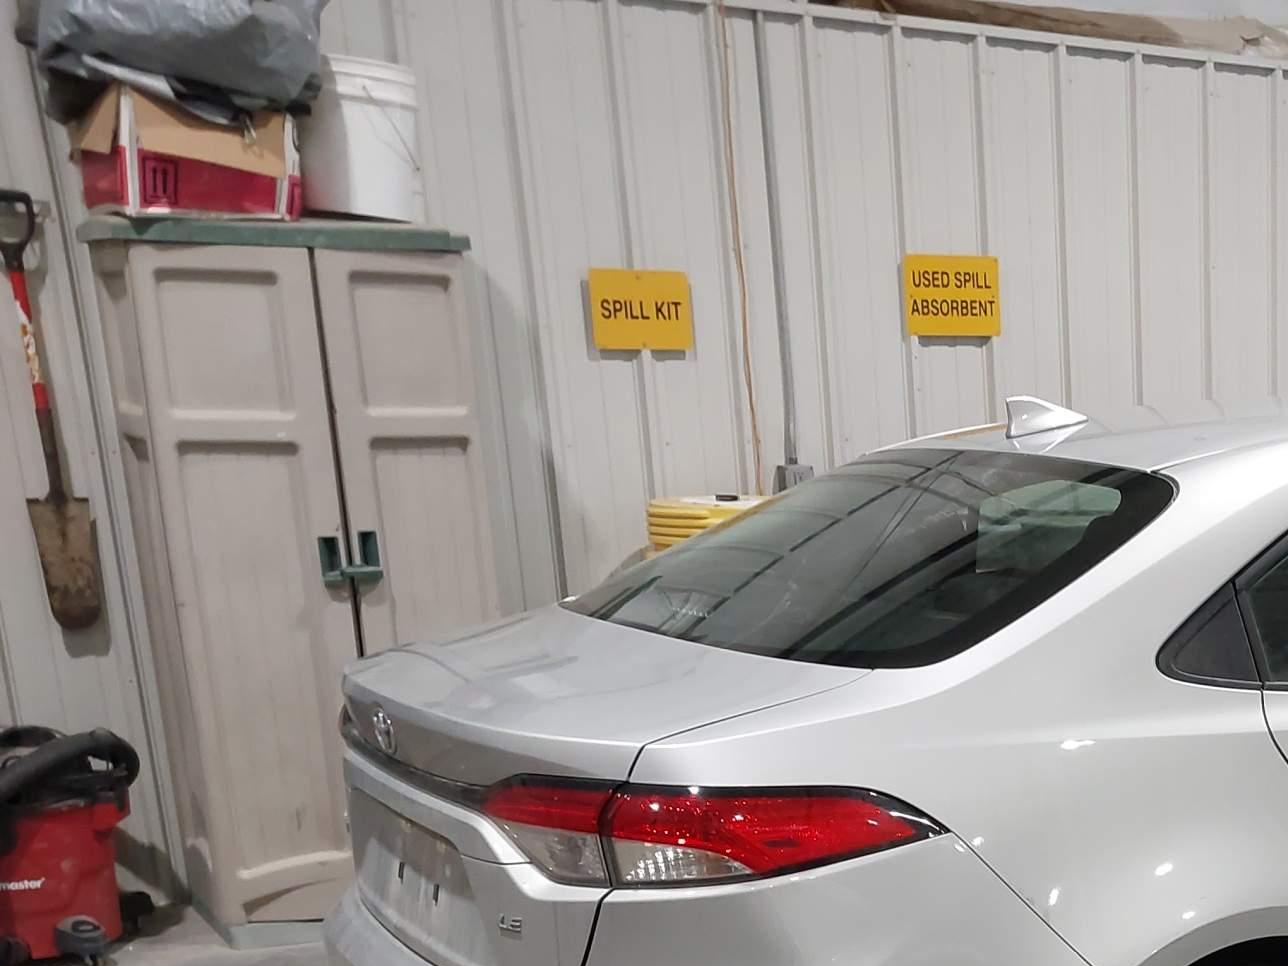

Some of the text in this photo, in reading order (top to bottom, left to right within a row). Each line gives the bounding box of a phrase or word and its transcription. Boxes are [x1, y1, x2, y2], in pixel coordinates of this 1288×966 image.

[912, 270, 992, 290] USED SPILL
[600, 298, 682, 321] SPILL KIT
[910, 296, 996, 317] ABSORBENT
[498, 913, 522, 932] LE
